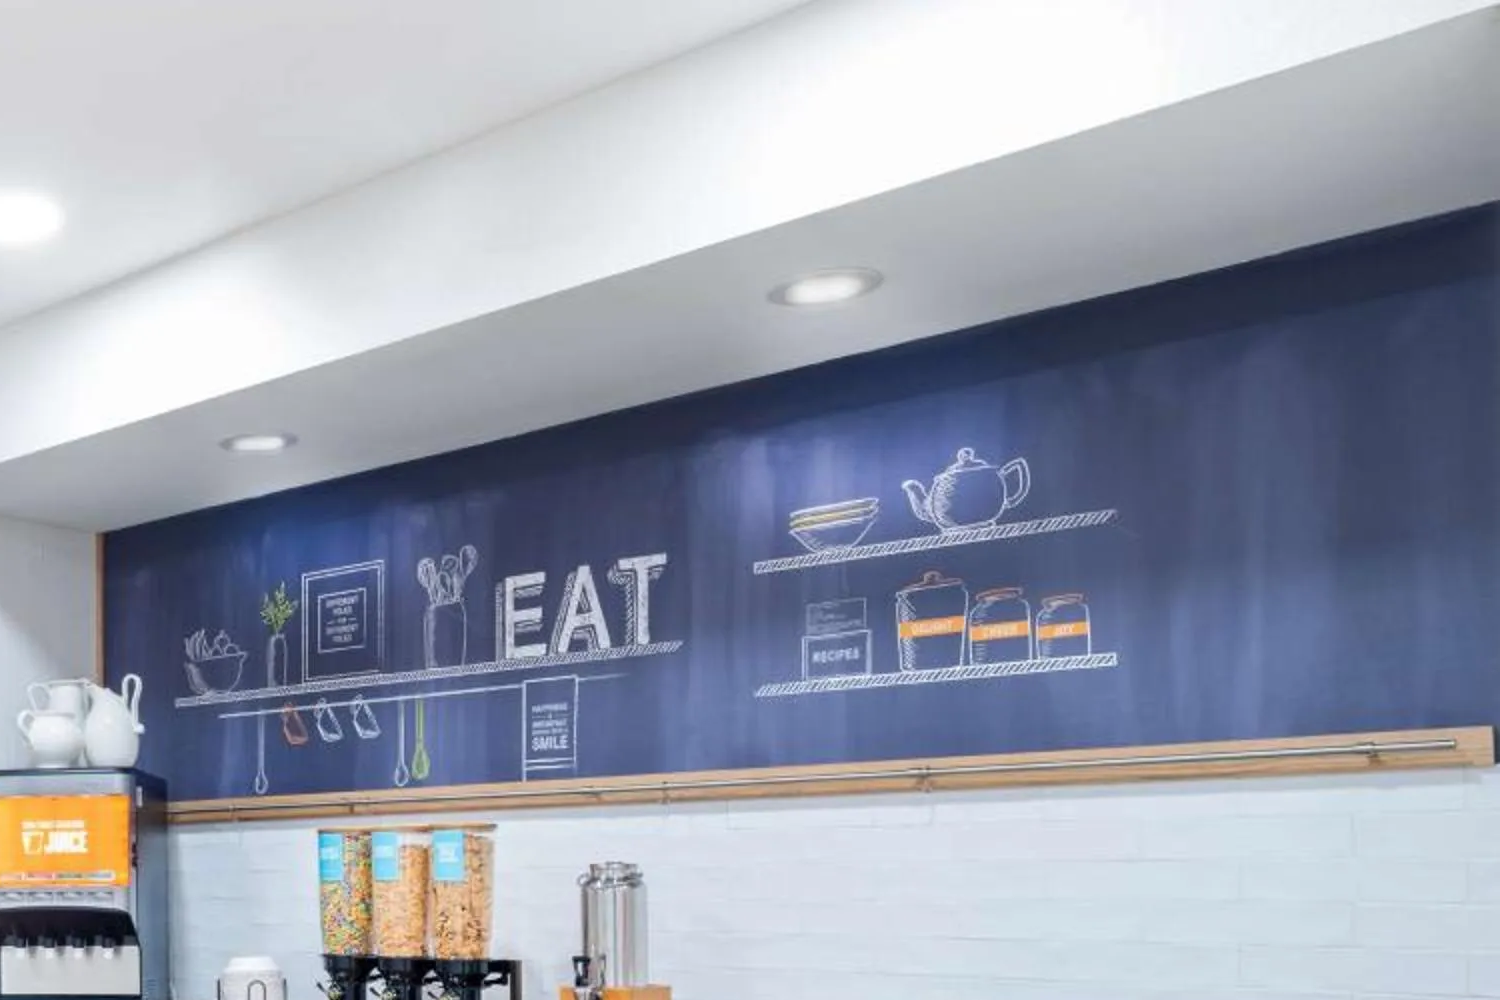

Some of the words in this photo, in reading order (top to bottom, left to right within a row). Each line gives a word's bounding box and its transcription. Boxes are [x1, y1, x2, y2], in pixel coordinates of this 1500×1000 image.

[497, 553, 667, 661] EAT
[812, 646, 860, 664] RECIPES
[531, 734, 569, 752] SMILE
